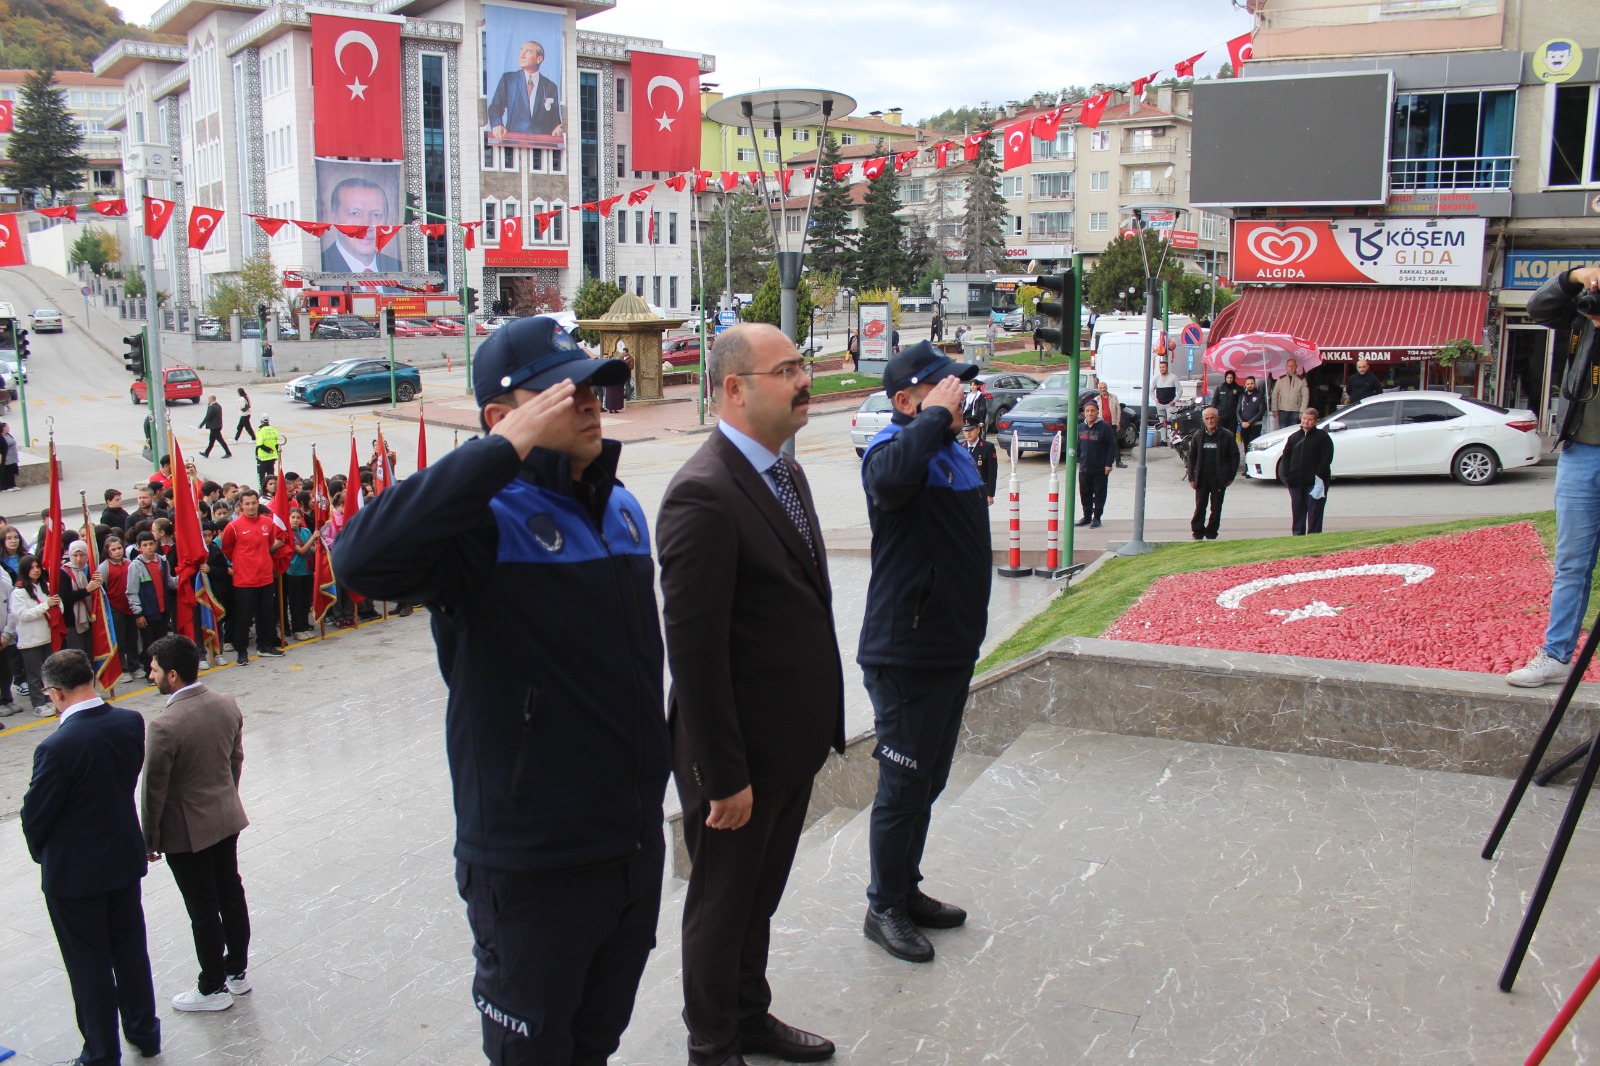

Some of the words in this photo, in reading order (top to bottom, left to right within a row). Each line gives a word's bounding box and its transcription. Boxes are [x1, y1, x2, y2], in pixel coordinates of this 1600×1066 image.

[1386, 228, 1465, 250] KÖŞEM
[1395, 250, 1453, 265] GIDA
[1256, 267, 1306, 279] ALGIDA
[1570, 334, 1580, 355] Nikon
[1592, 365, 1600, 385] Nikon
[881, 745, 919, 771] ZABITA
[476, 992, 530, 1037] ZABITA
